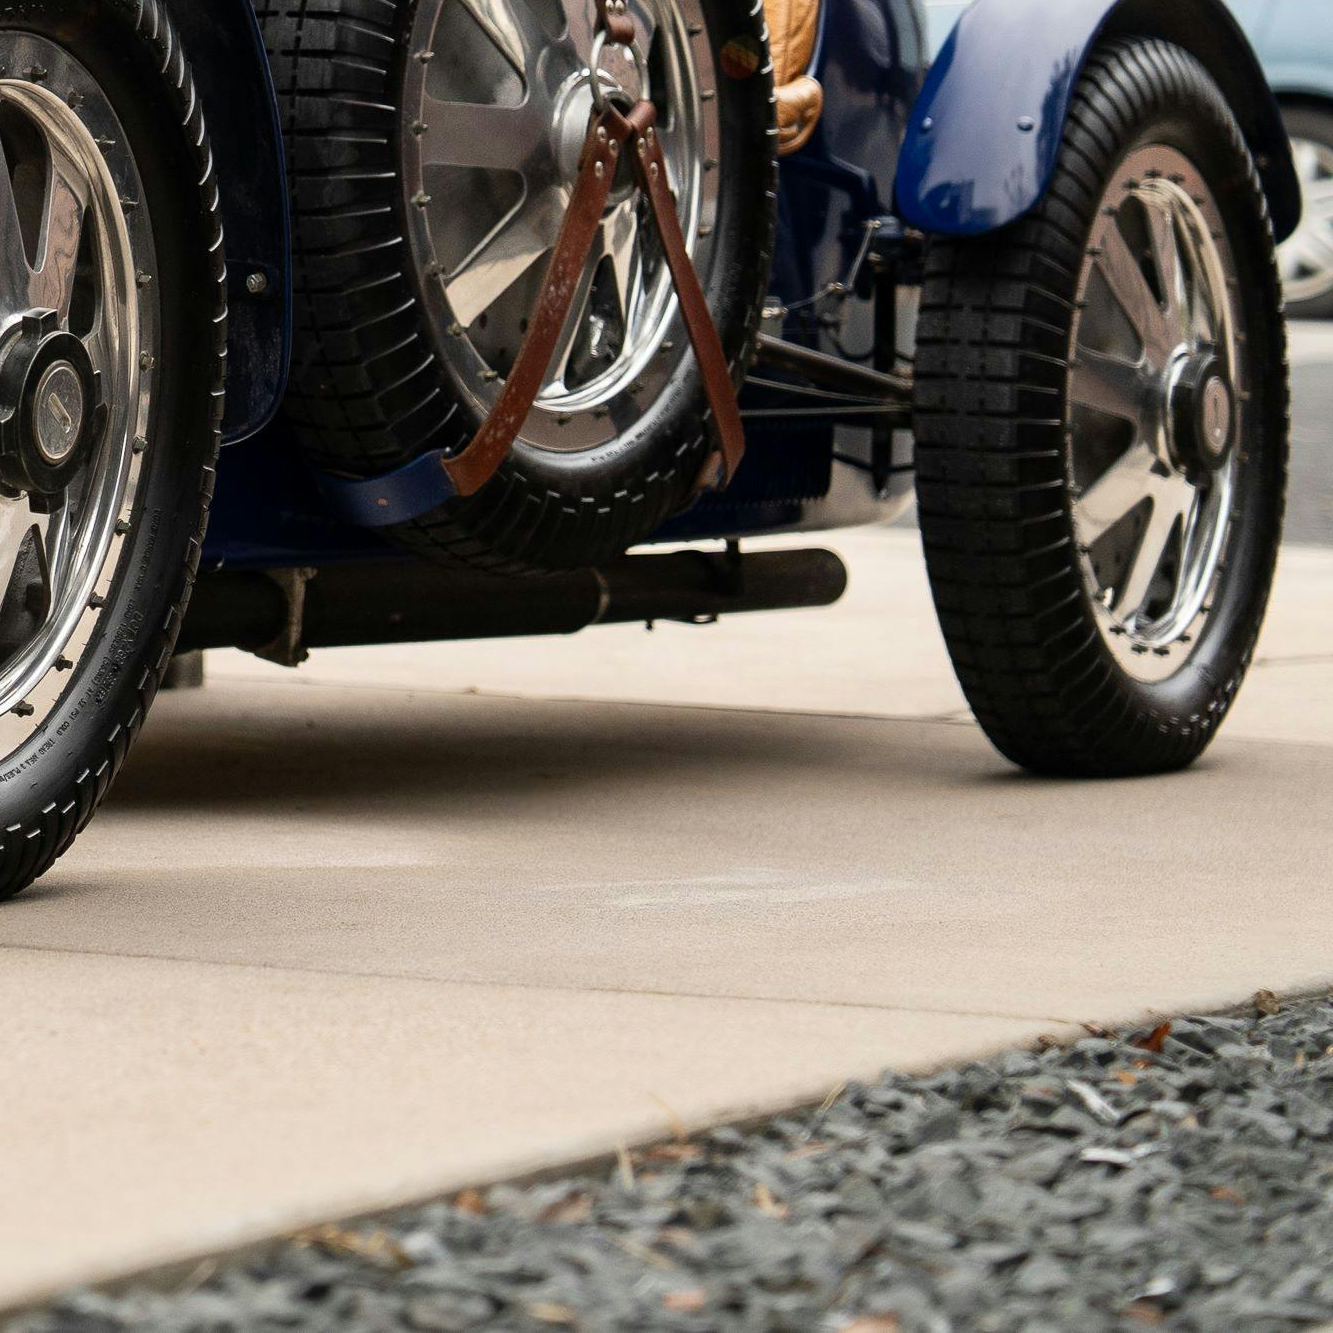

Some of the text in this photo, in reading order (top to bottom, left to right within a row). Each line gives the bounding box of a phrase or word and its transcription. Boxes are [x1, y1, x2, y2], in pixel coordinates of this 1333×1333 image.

[127, 609, 144, 634] DOT
[68, 707, 81, 721] PSI
[55, 720, 71, 737] COLD
[37, 737, 56, 755] TREAD
